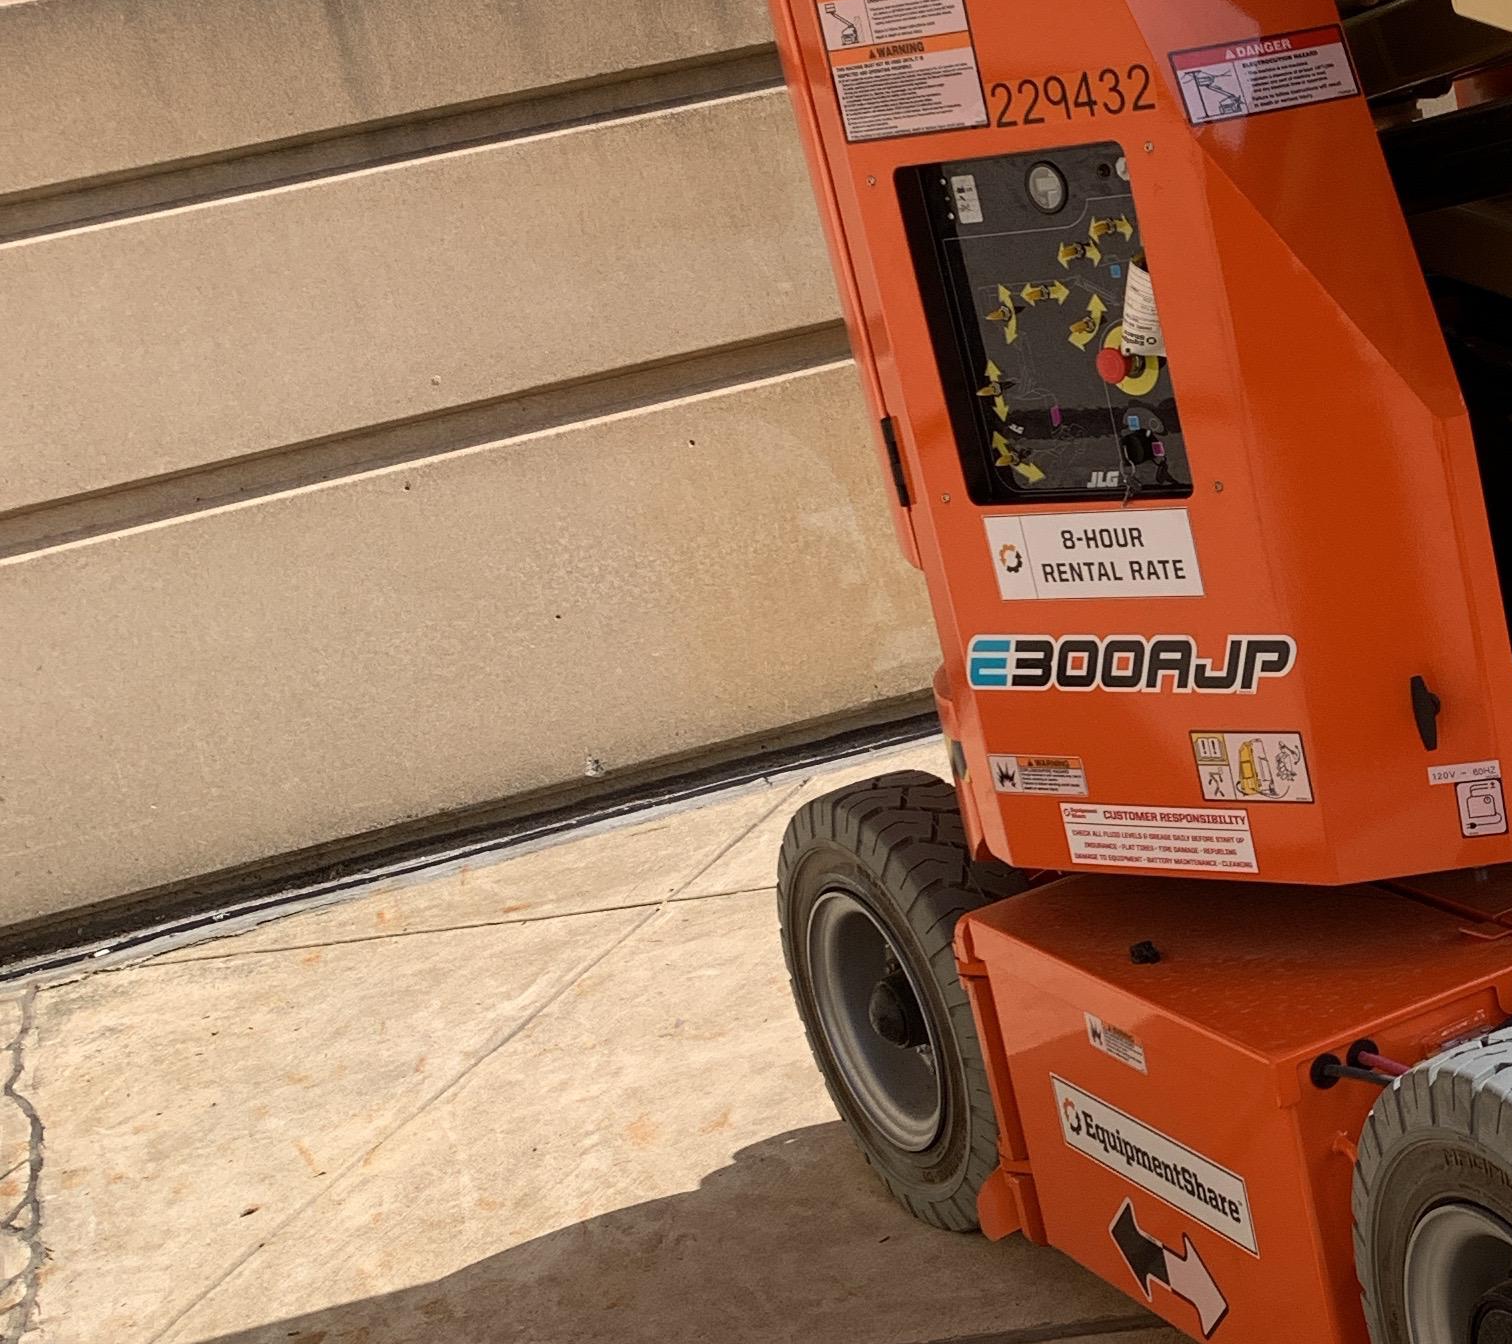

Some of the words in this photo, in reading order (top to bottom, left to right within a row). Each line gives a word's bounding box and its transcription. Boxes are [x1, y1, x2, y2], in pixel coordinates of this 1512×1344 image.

[877, 42, 925, 58] WARNING
[1237, 39, 1292, 57] DANGER
[990, 63, 1156, 128] 229432
[1087, 471, 1119, 488] JLG
[1060, 527, 1145, 550] 8-HOUR
[1041, 562, 1124, 583] RENTAL
[1129, 560, 1186, 580] RATE
[969, 638, 1293, 691] E300AJP
[1432, 771, 1456, 780] 120V
[1103, 811, 1158, 823] CUSTOMER
[1160, 813, 1246, 825] RESPONSIBILITY
[1081, 1110, 1242, 1225] EquipmentShare
